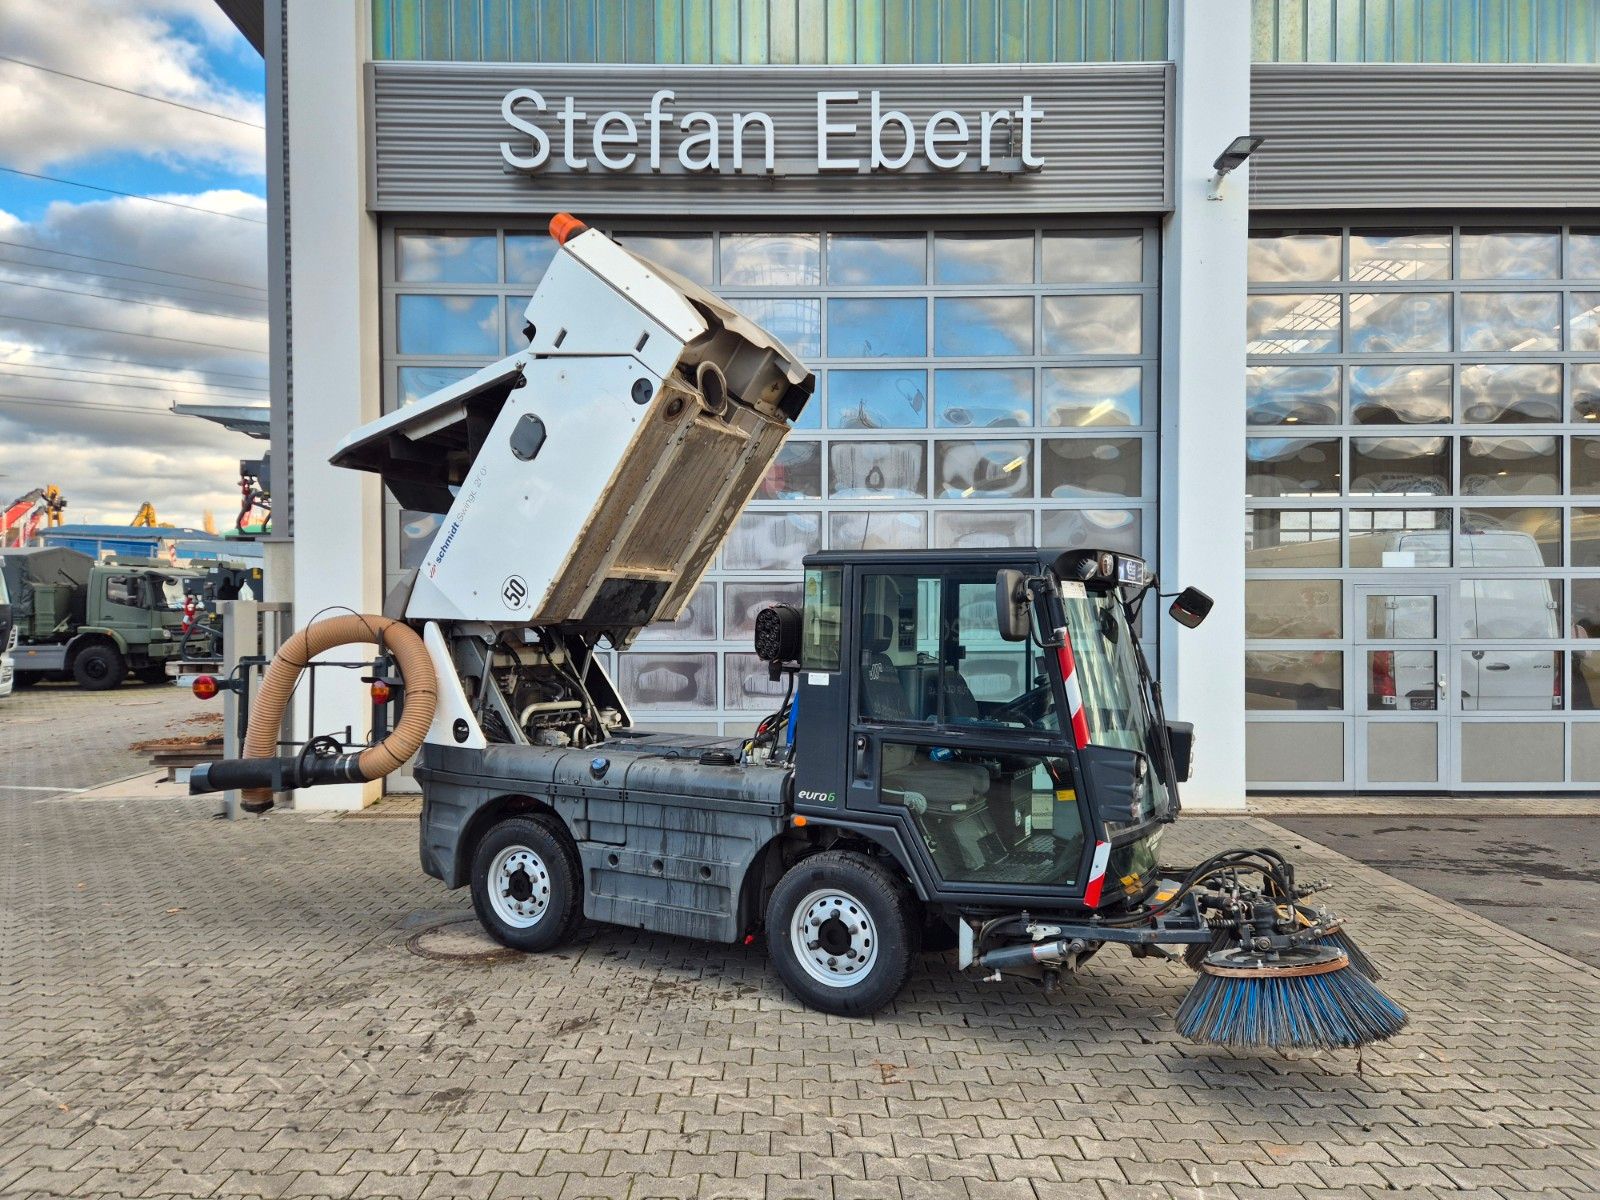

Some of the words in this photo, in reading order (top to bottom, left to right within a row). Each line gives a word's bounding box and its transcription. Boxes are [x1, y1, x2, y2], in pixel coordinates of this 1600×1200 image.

[499, 88, 775, 172] Stefan
[817, 90, 1045, 171] Ebert
[436, 521, 460, 563] schmidt
[503, 578, 526, 606] 50
